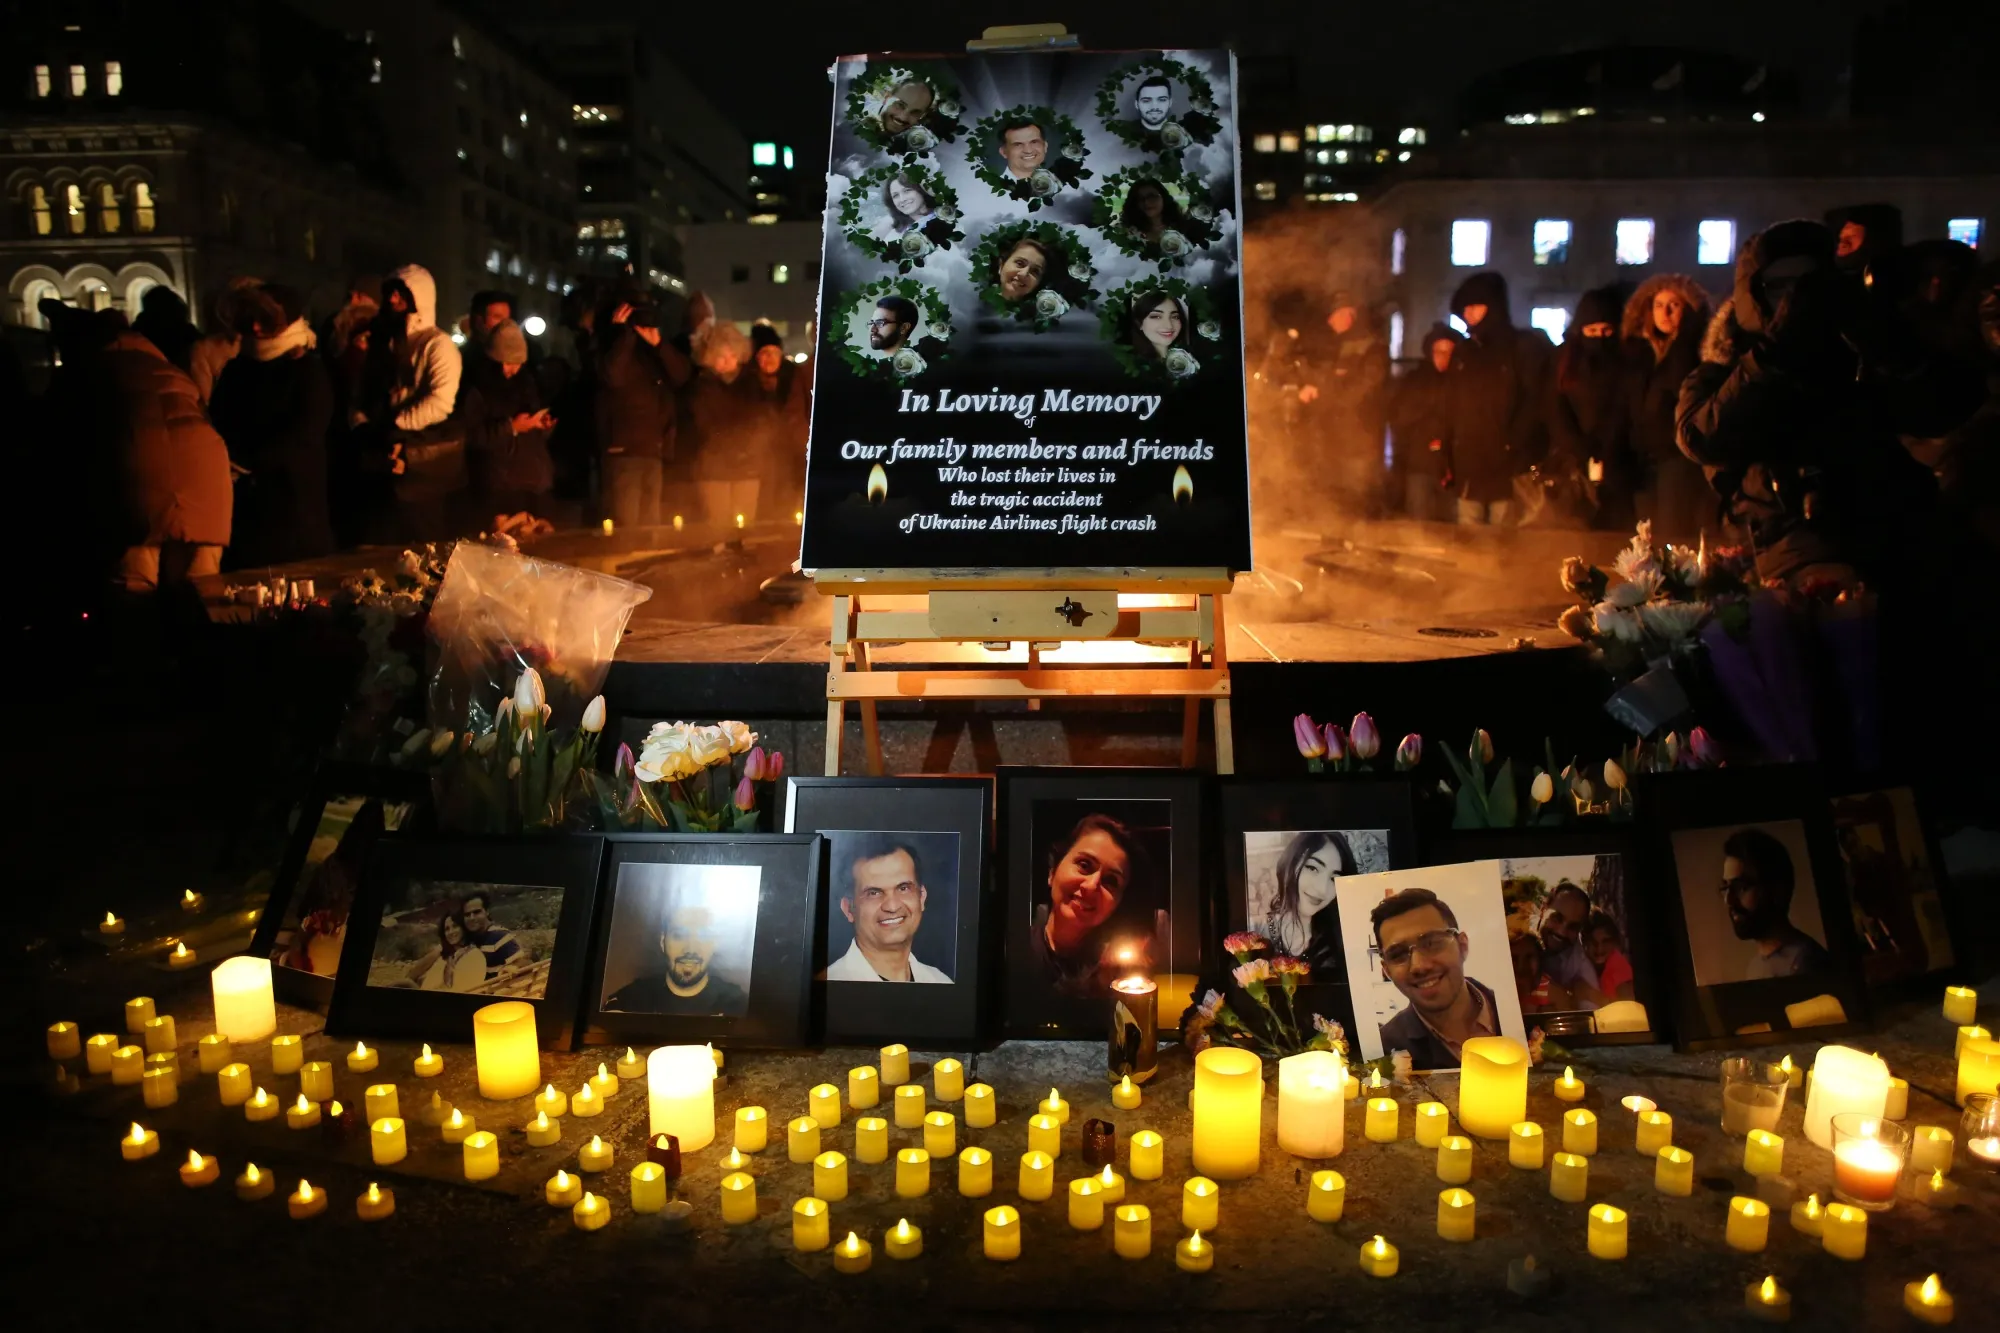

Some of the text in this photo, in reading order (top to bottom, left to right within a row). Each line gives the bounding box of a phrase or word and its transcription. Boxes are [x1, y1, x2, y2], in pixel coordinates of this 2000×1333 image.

[898, 387, 1161, 420] In Loving Memory
[1024, 416, 1036, 428] of
[841, 437, 1214, 465] Our family members and friends
[938, 466, 1116, 483] Who lost their lives in
[951, 490, 1103, 510] the tragic accident
[899, 513, 1156, 534] of Ukraine Airlines flight crash
